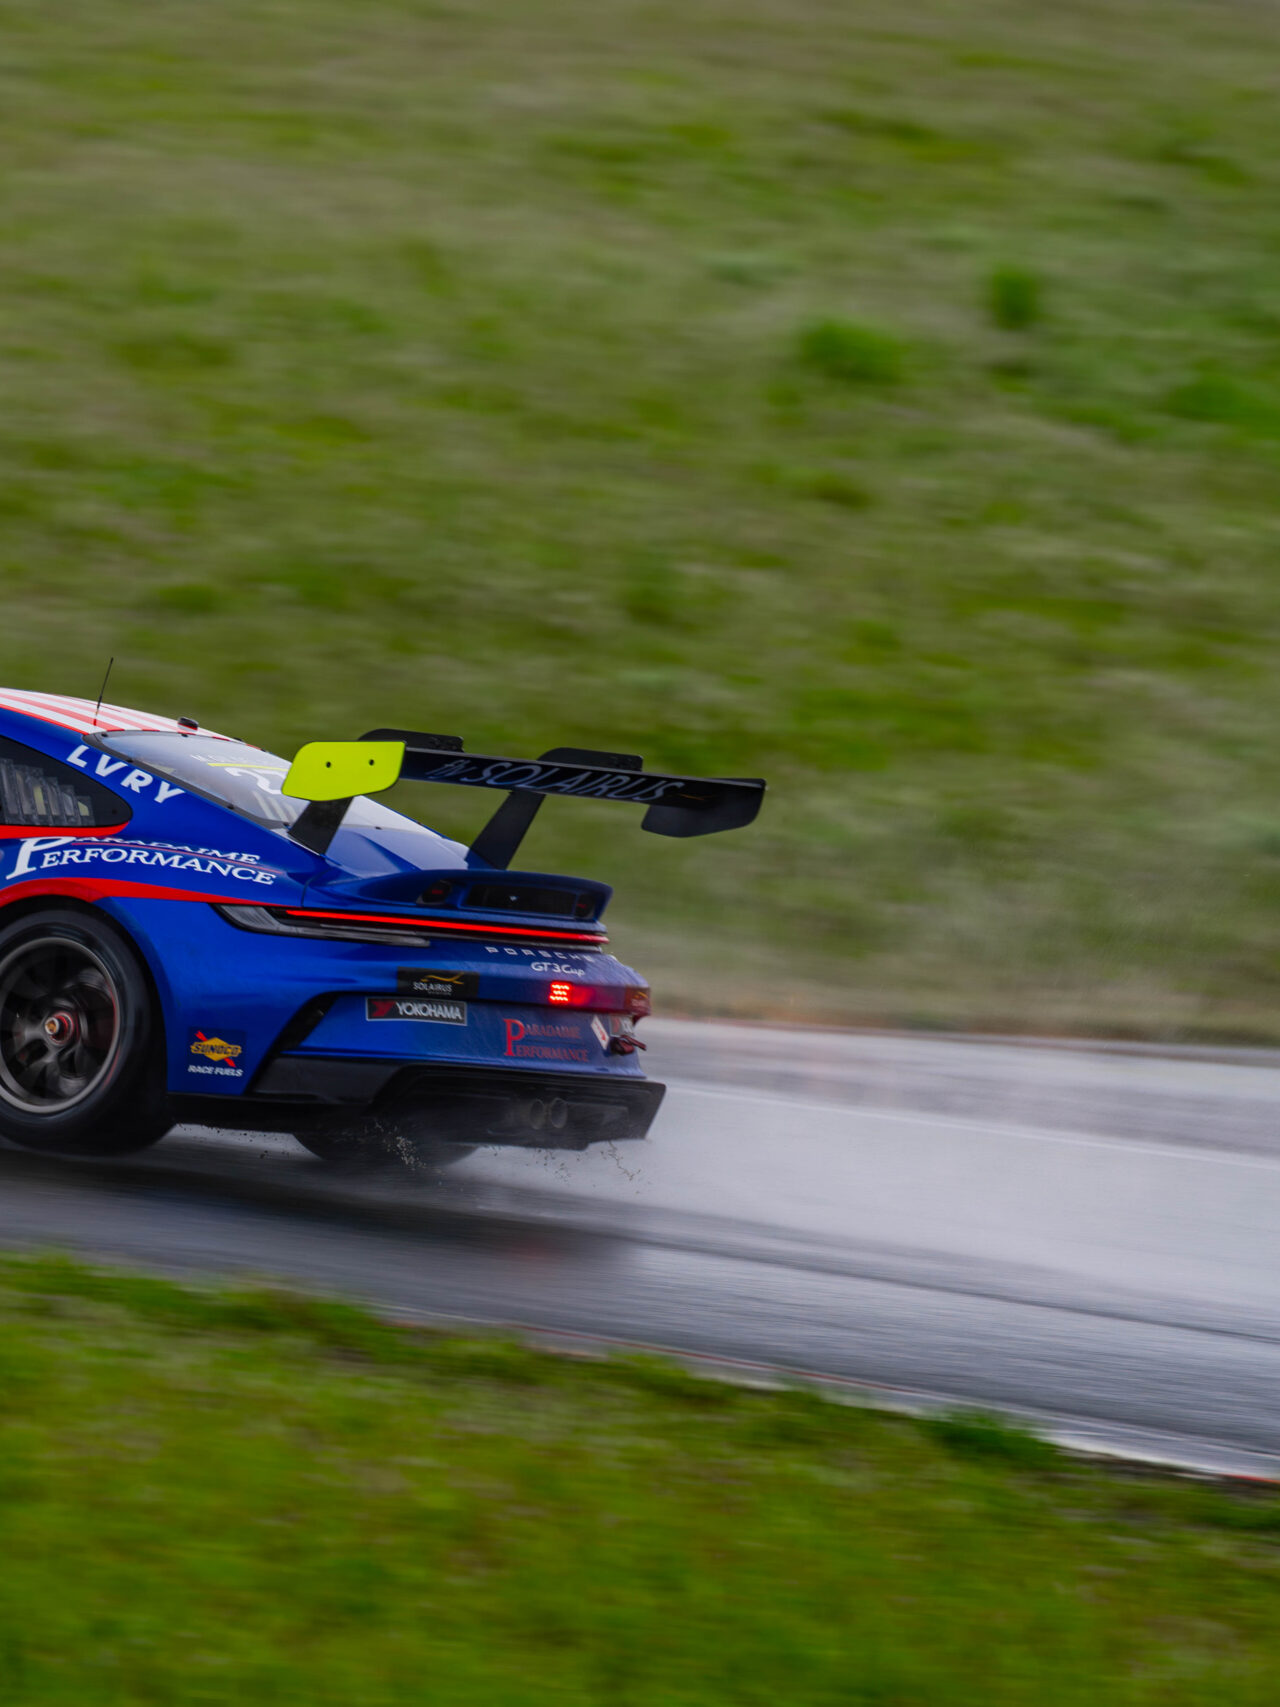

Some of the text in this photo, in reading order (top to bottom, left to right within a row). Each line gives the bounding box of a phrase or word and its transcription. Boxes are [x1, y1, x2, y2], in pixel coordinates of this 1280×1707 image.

[66, 745, 186, 804] LVRY
[461, 762, 685, 801] SOLAIRUS
[484, 946, 595, 963] PORSCHE
[413, 981, 453, 992] SOLAIRUS
[396, 1001, 462, 1020] YOKOHAMA
[190, 1042, 242, 1057] SUNOCO
[188, 1065, 243, 1077] RACE FUELS
